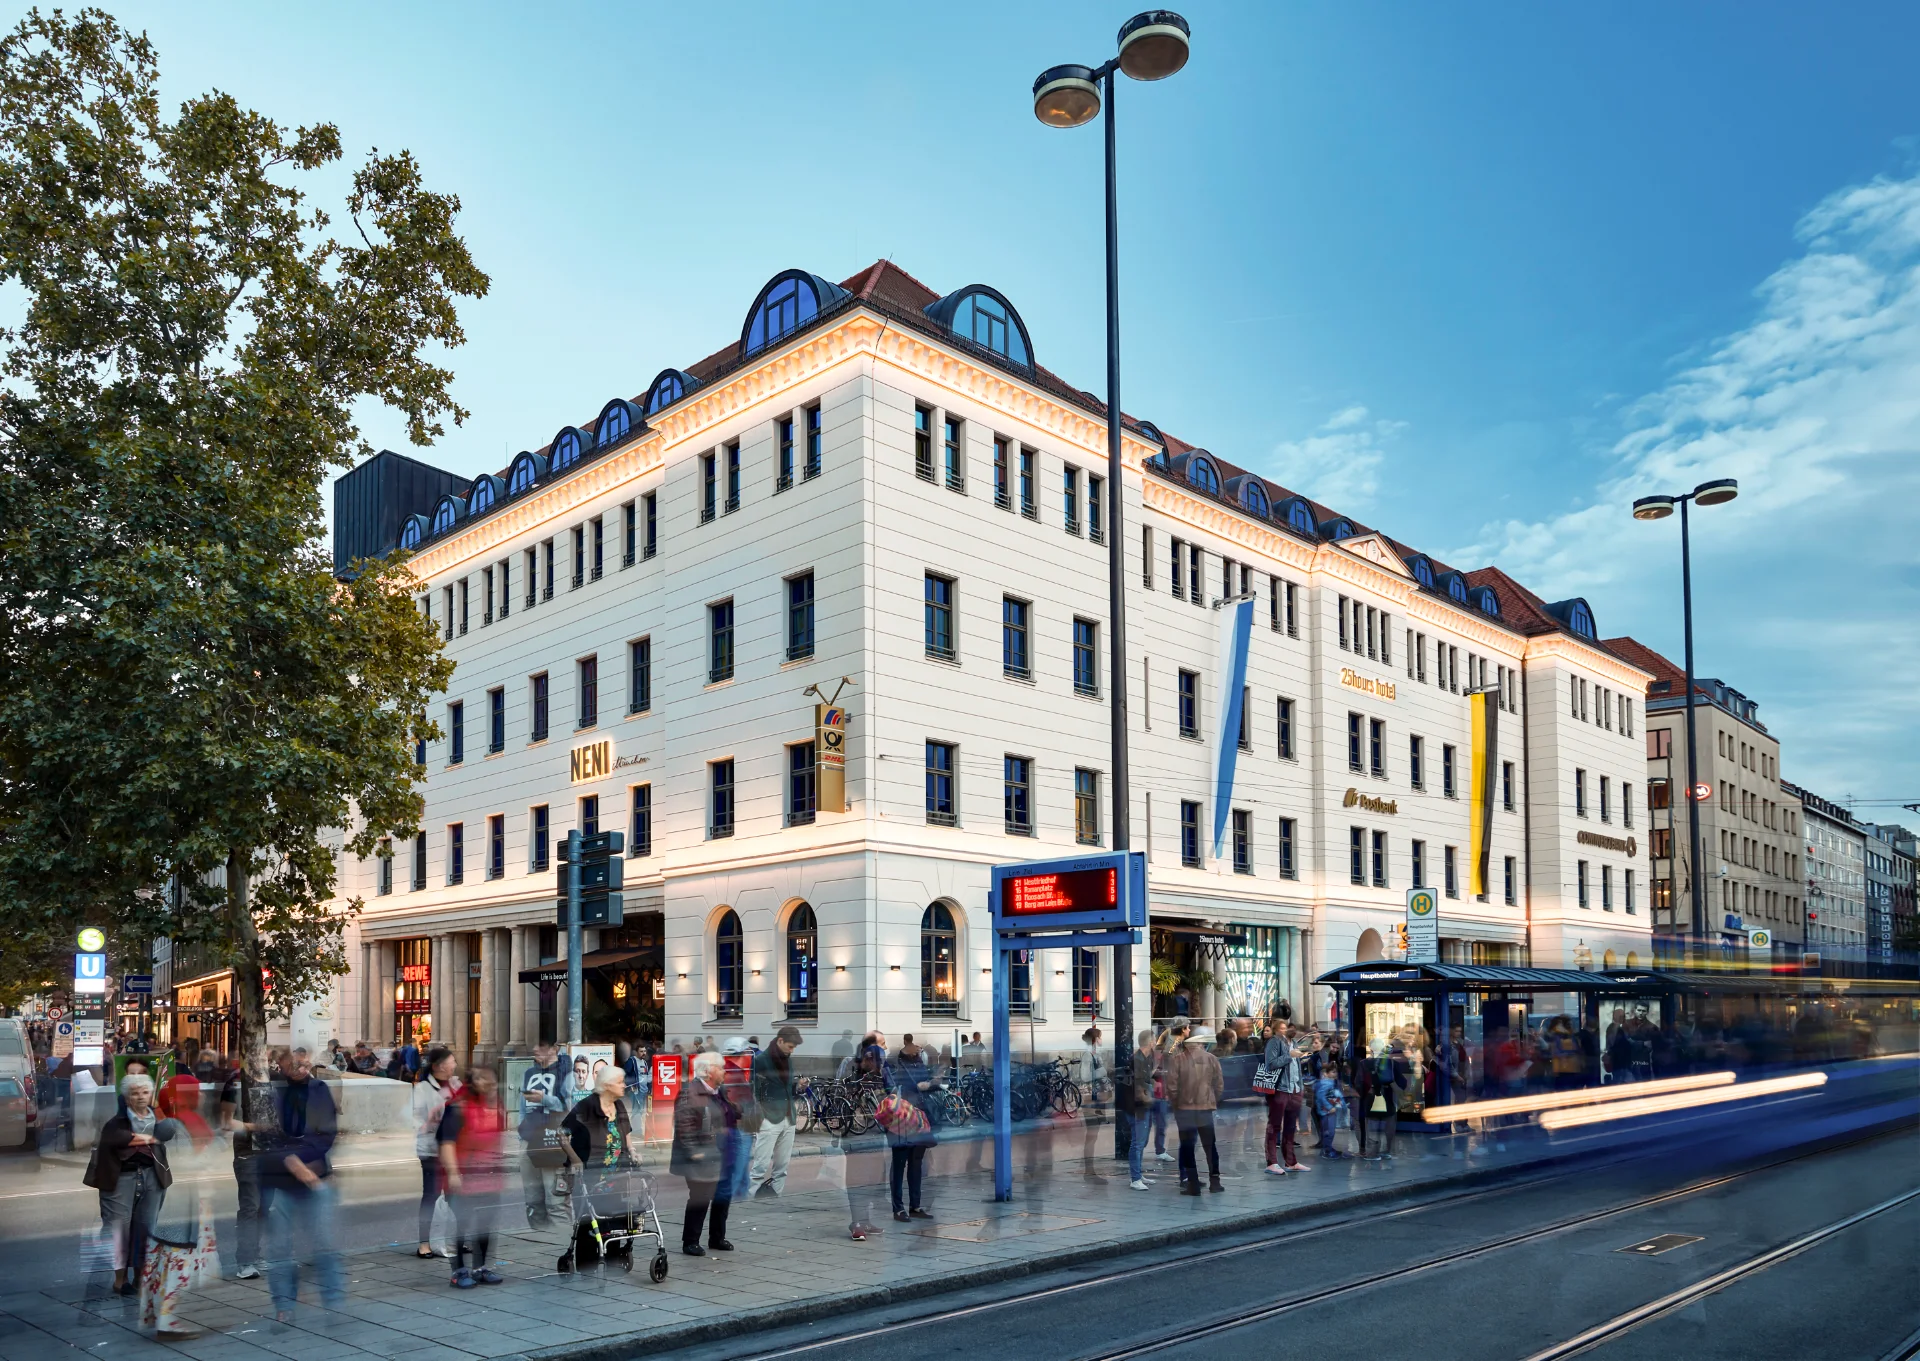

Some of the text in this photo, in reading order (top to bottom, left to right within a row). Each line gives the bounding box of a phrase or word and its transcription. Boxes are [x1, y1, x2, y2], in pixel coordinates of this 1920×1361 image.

[1341, 667, 1396, 700] 25hours hotel
[571, 740, 610, 782] NENI
[824, 755, 842, 763] DHL
[1360, 794, 1398, 815] Postbank
[1111, 870, 1115, 878] 1
[1024, 885, 1053, 894] Romanplatz
[1111, 878, 1115, 886] 3
[1111, 886, 1115, 894] 5
[81, 928, 101, 951] S
[1199, 935, 1224, 944] 25hours hotel
[81, 956, 100, 977] U
[404, 965, 429, 981] REWE
[1360, 972, 1399, 980] Hauptbahnhof
[659, 1062, 676, 1083] tz
